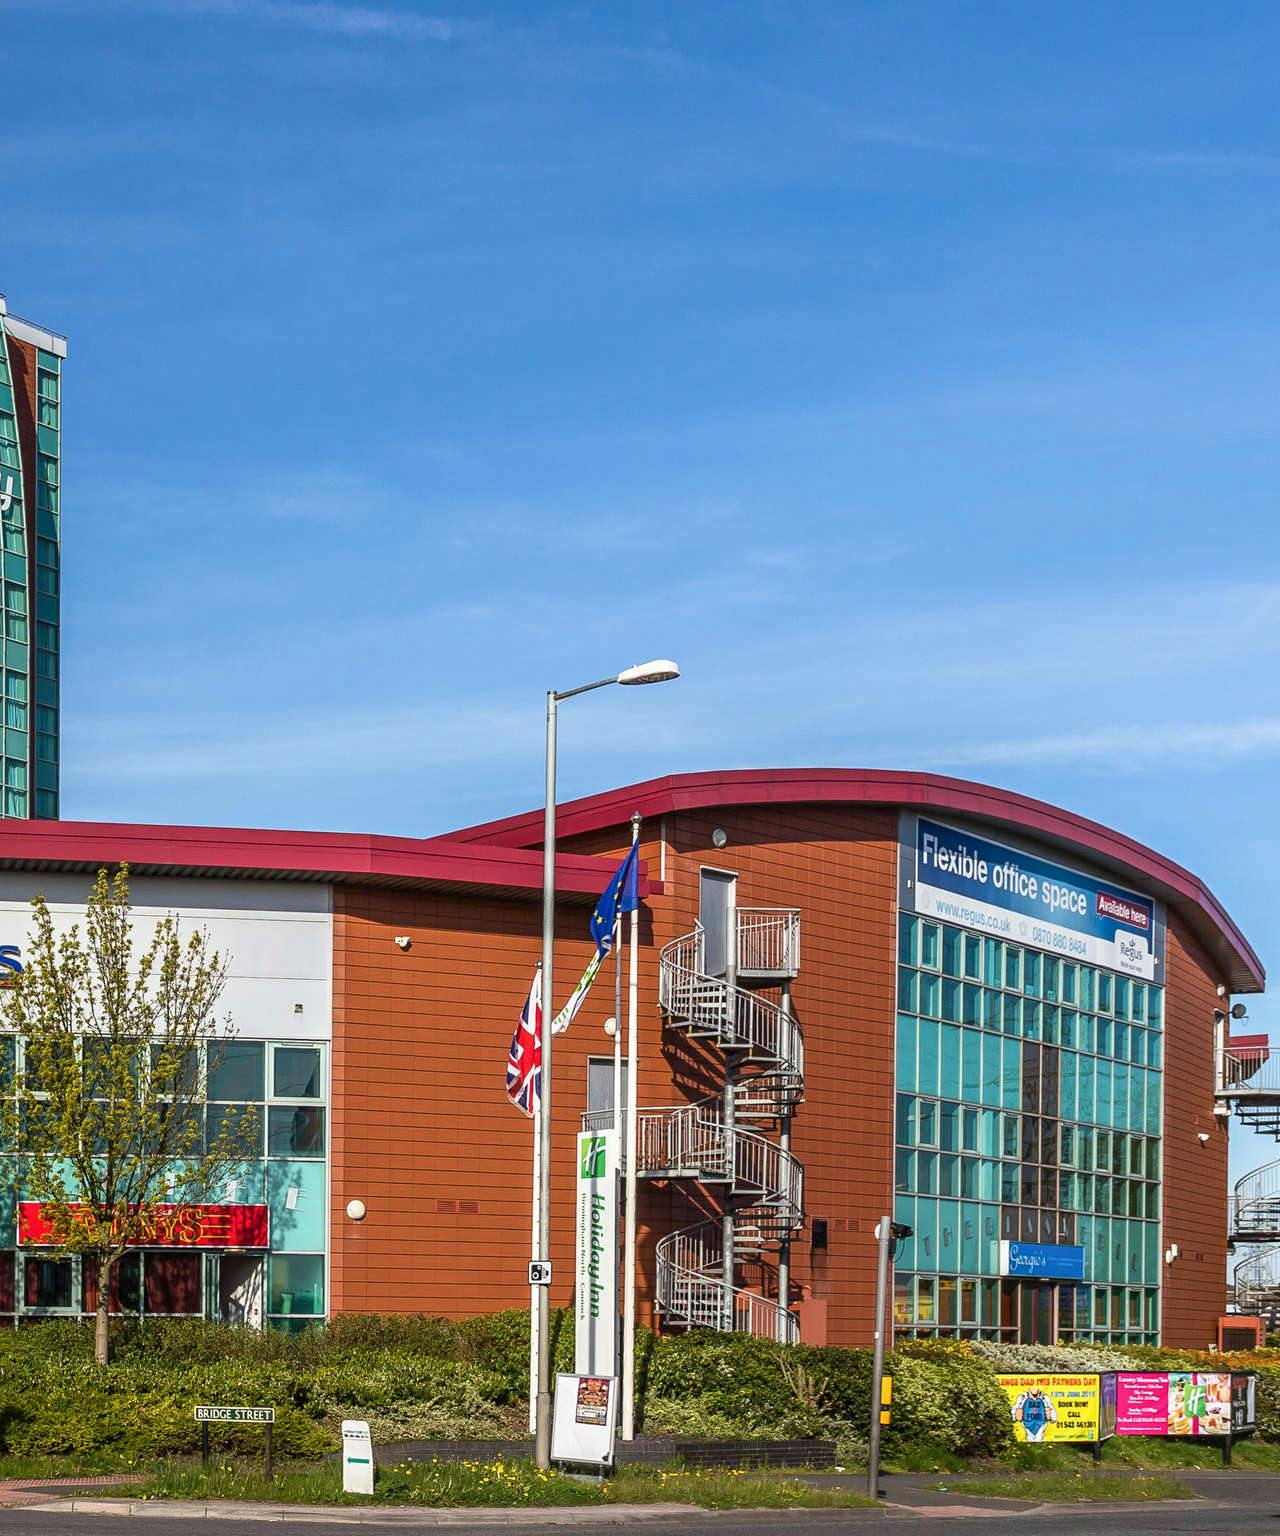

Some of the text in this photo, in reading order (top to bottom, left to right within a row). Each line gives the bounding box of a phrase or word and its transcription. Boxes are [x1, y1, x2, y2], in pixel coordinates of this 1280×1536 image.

[922, 832, 1087, 916] Flexible office space
[1099, 895, 1147, 925] Available here
[935, 898, 1087, 956] www.regus.co.uk 0870 880 8484
[1120, 942, 1143, 962] Regus
[587, 1192, 606, 1318] Holiday Inn
[1010, 1245, 1046, 1273] Georgio's
[1020, 1378, 1035, 1386] DAD
[1052, 1377, 1081, 1386] FATHERS
[1083, 1377, 1097, 1386] DAY
[197, 1408, 271, 1421] BRIDGE STREET
